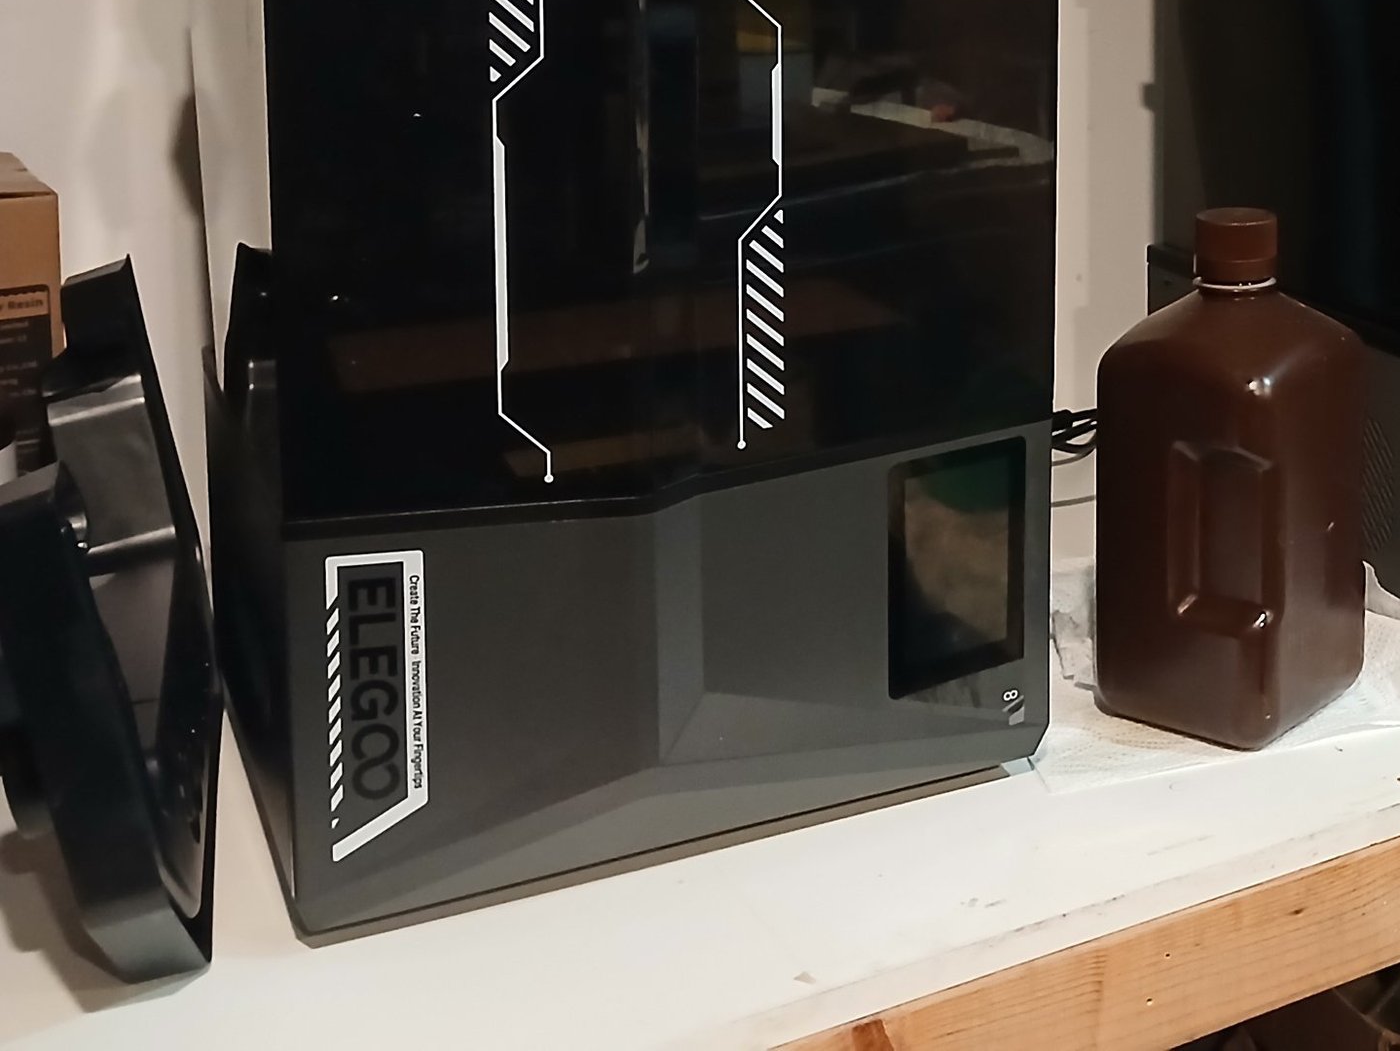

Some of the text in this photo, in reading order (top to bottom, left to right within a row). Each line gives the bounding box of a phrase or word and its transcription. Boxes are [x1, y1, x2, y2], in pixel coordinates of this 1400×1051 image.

[409, 574, 421, 605] Create
[410, 606, 421, 623] The
[410, 625, 421, 655] Future
[347, 576, 401, 801] ELEGOO
[411, 660, 422, 708] Innovation
[412, 722, 423, 742] Your
[410, 743, 424, 789] Fingertips
